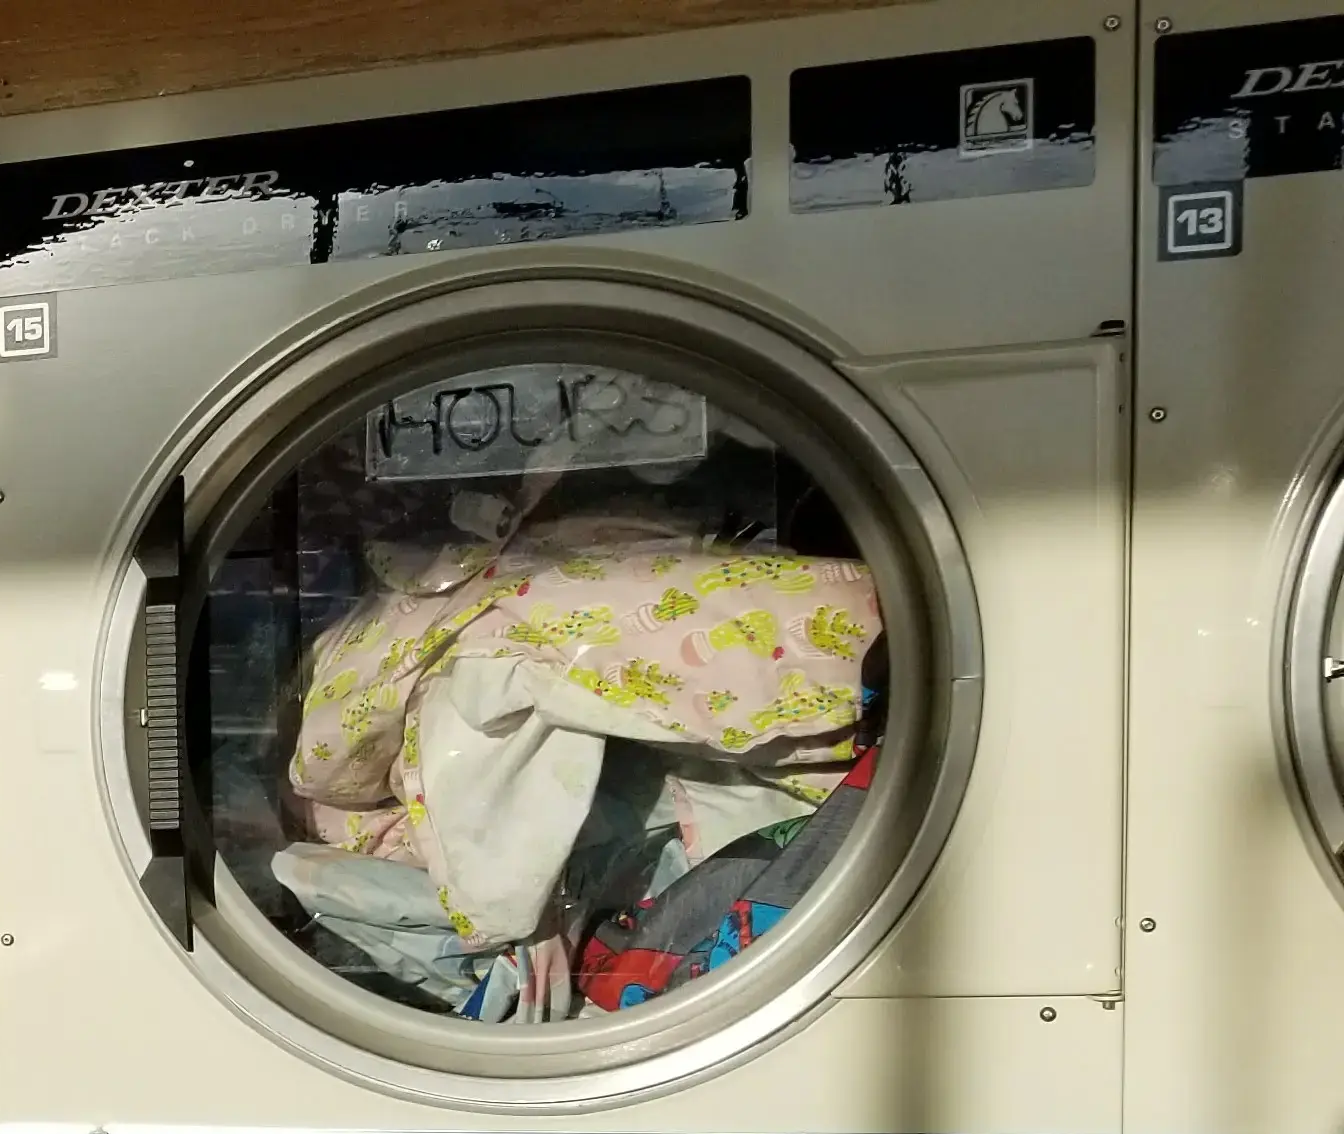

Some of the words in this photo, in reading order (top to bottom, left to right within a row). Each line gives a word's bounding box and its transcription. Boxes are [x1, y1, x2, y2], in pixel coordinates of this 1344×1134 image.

[42, 171, 280, 222] DEXTER
[1176, 207, 1224, 236] 13
[7, 316, 44, 343] 15
[378, 374, 690, 458] HOURS
